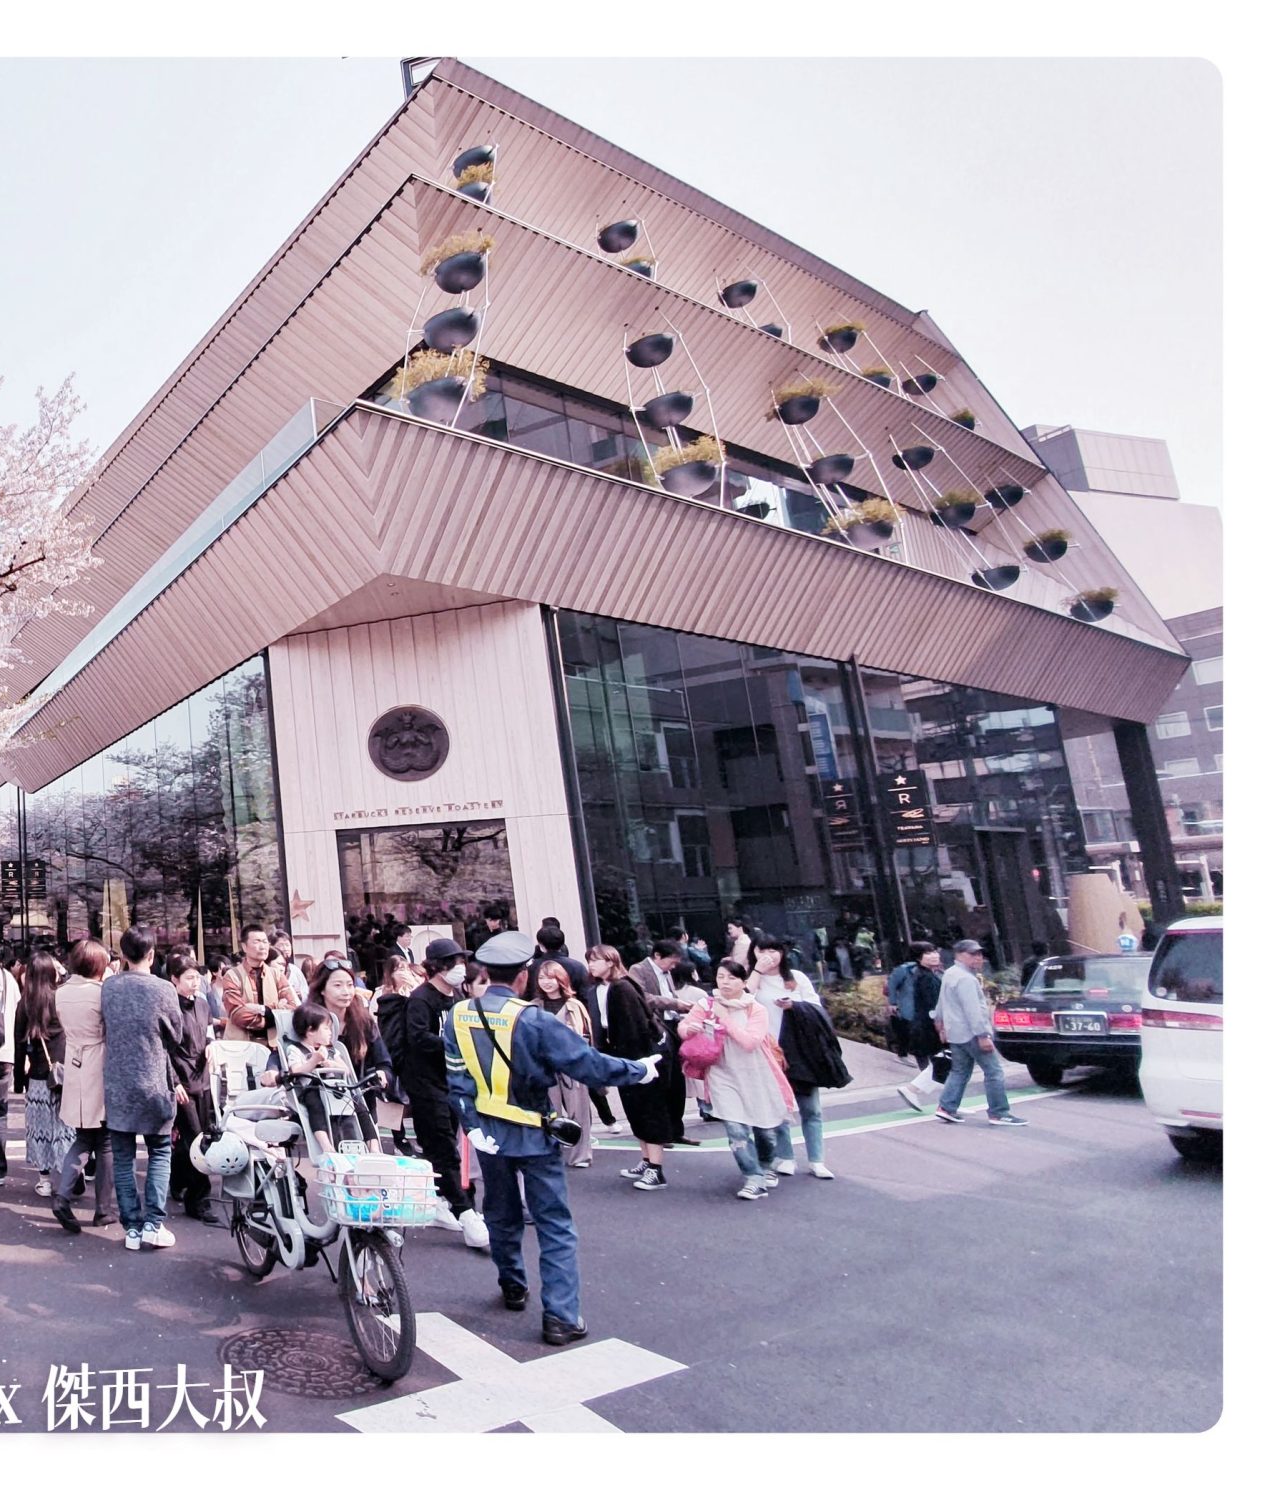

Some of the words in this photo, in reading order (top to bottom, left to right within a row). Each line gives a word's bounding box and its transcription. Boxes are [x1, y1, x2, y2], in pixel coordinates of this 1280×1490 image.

[898, 793, 911, 804] R
[333, 808, 388, 821] STARBUCKS
[394, 806, 441, 816] RESERVE
[443, 800, 504, 812] ROASTERY
